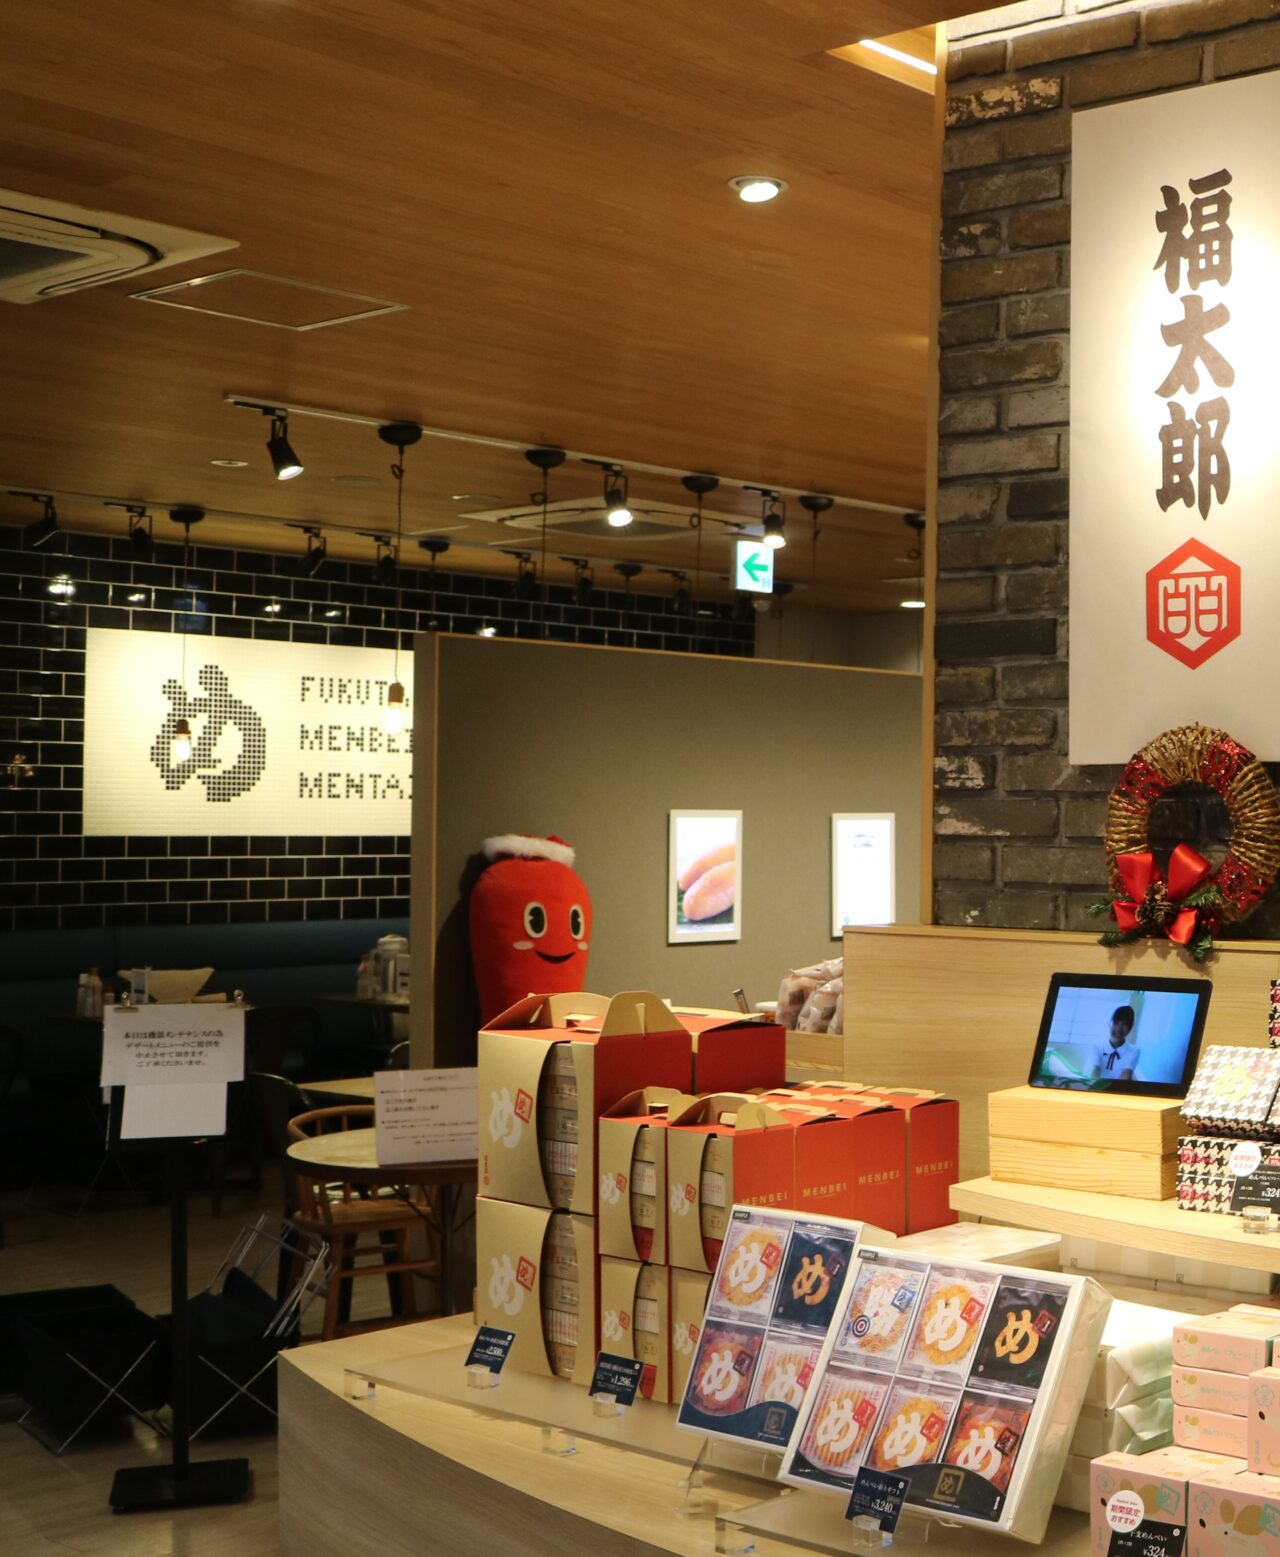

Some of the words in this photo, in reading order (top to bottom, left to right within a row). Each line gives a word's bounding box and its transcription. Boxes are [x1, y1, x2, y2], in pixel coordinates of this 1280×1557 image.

[1153, 167, 1236, 521] 福太郎
[299, 771, 413, 799] MENTA
[802, 1182, 847, 1198] MENBEI
[858, 1170, 900, 1185] MENBEI
[915, 1160, 954, 1175] MENBEI
[728, 1242, 769, 1294] め
[791, 1253, 831, 1306] め
[924, 1297, 969, 1352] め
[994, 1308, 1040, 1365] め
[701, 1350, 740, 1402] め
[816, 1398, 859, 1453] め
[883, 1412, 927, 1467] め
[956, 1426, 1002, 1481] め
[1110, 1504, 1141, 1517] 期間限定
[1111, 1515, 1136, 1526] おすすめ
